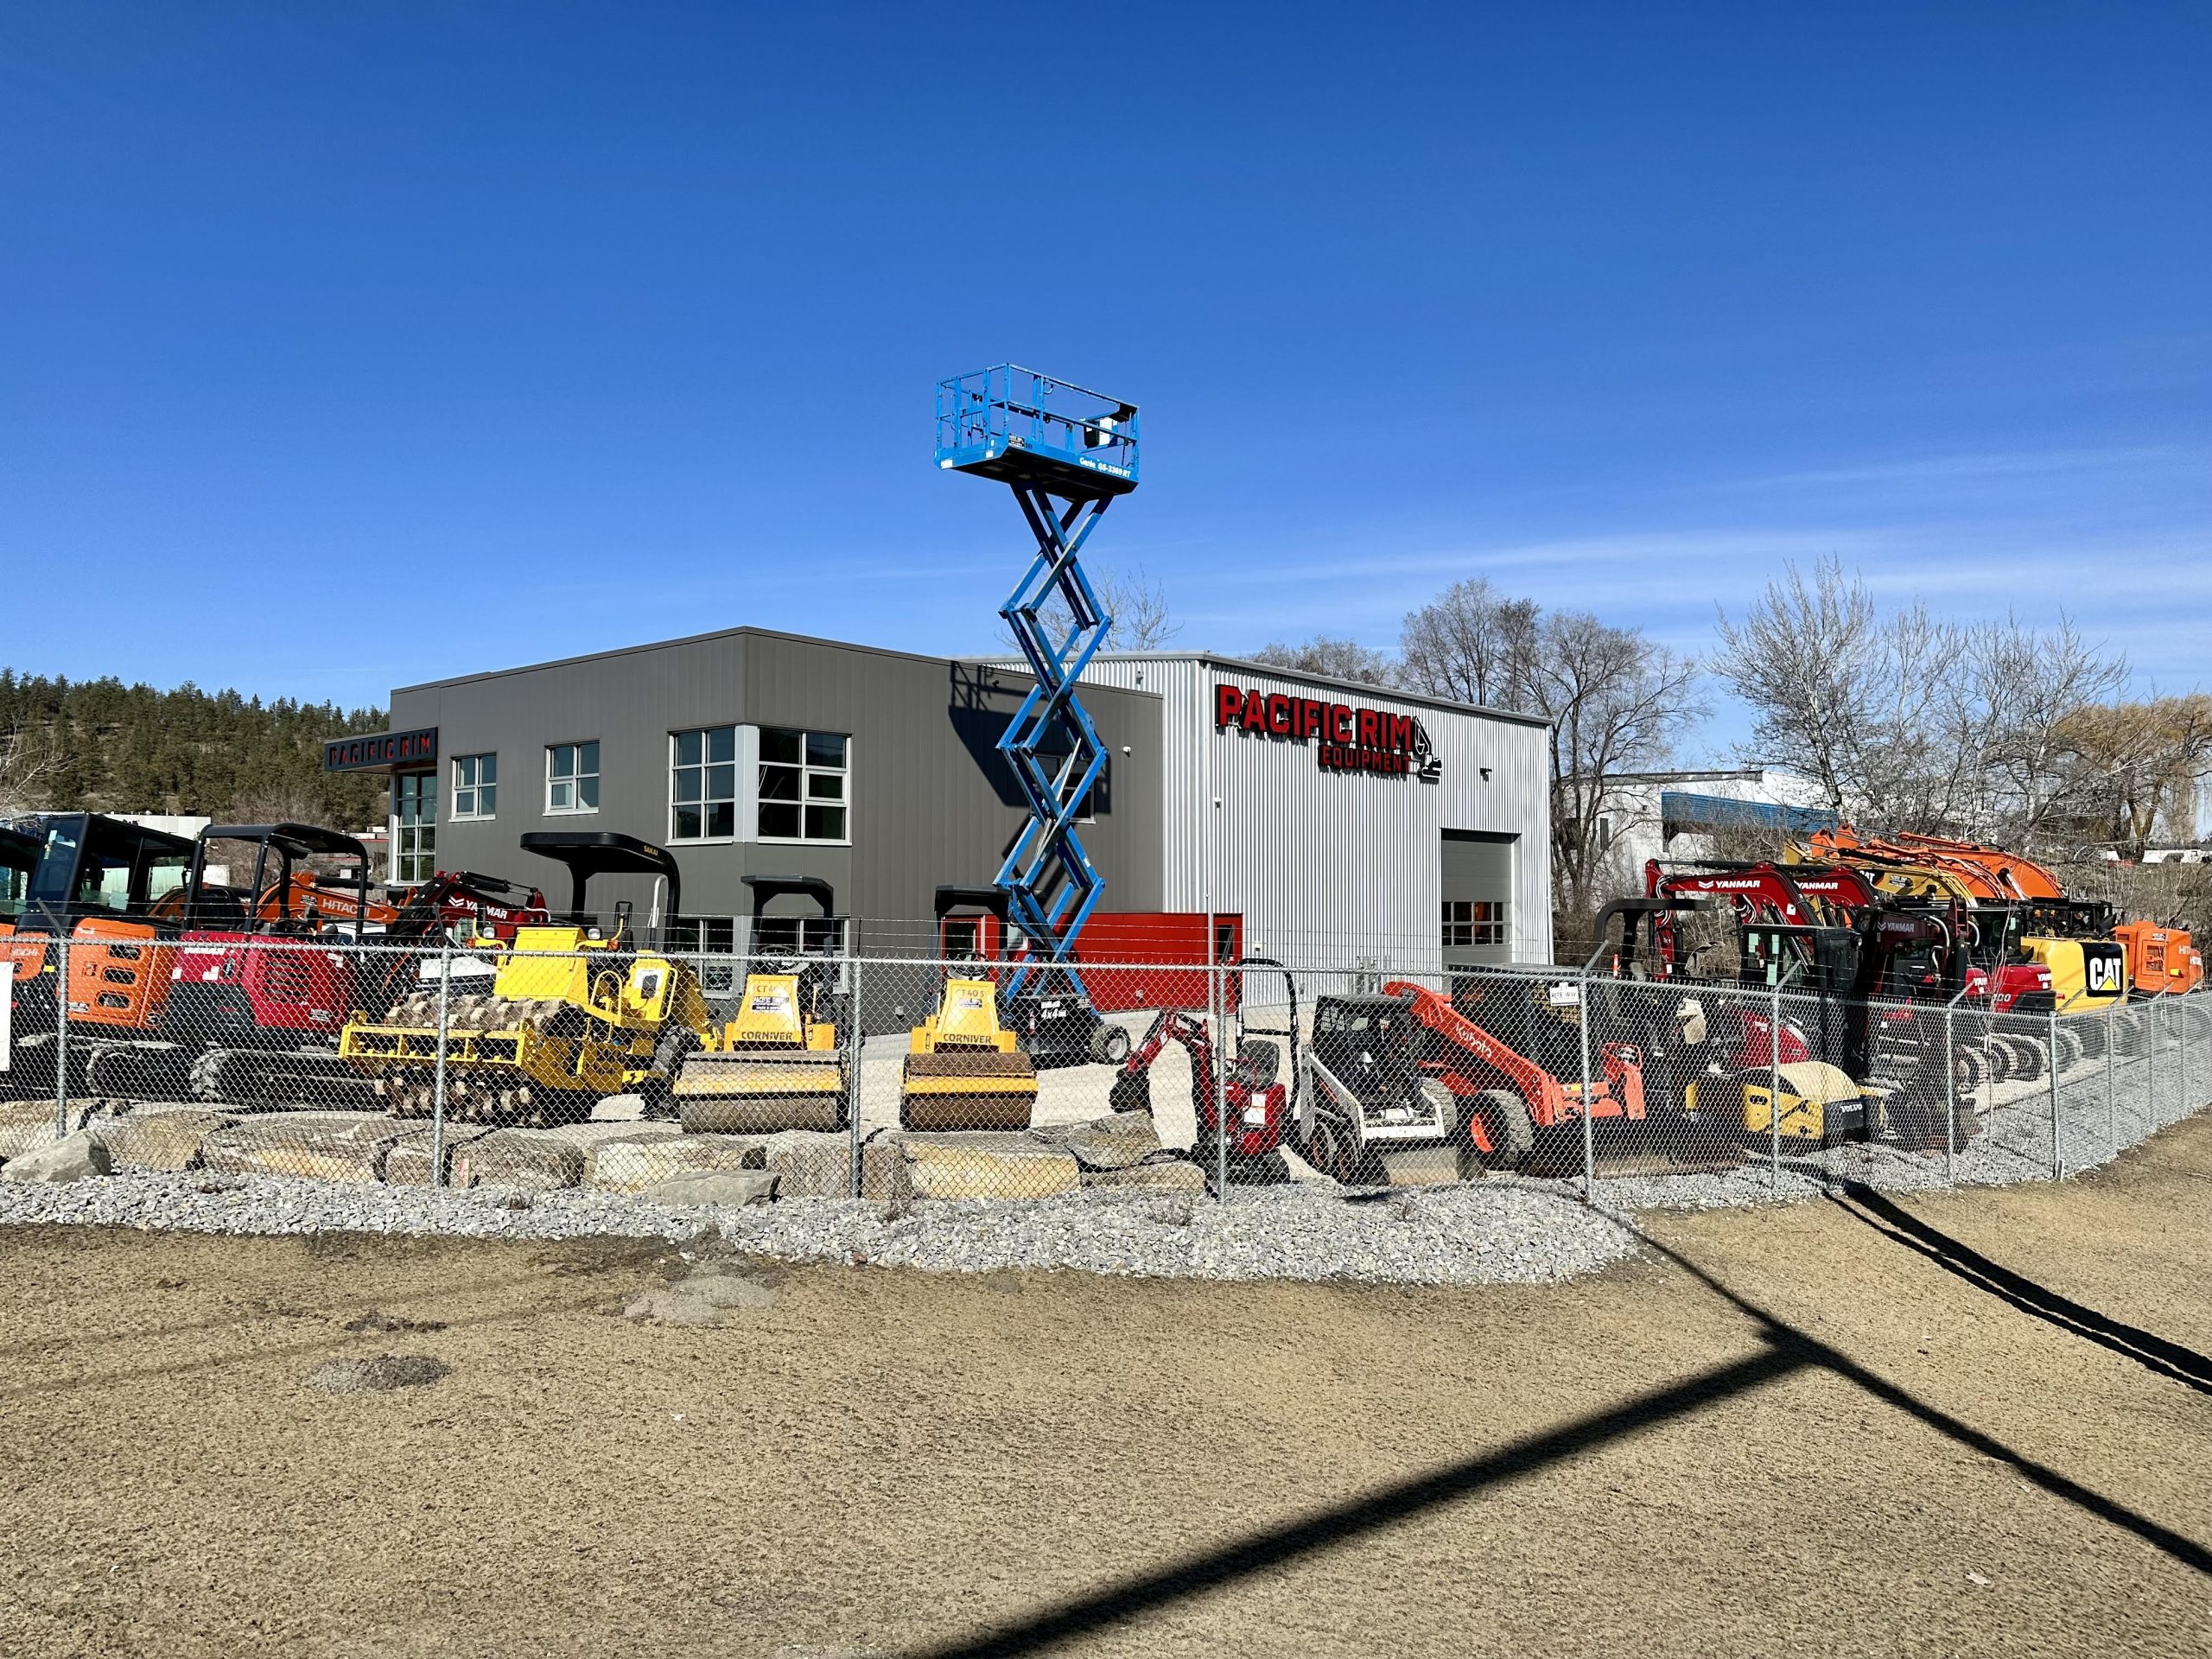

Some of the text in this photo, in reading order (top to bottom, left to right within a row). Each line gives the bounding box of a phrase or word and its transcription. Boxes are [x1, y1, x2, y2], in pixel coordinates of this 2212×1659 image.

[1215, 683, 1412, 753] PACIFIC RIM
[328, 732, 430, 766] PACIFIC RIM
[1318, 745, 1412, 774] EQUIPMENT
[1715, 880, 1761, 889] YANMAR
[1796, 881, 1839, 891] YANMAR
[322, 898, 372, 918] HITACI
[466, 899, 508, 920] YAMAR
[1886, 921, 1916, 933] YANMAR
[2089, 957, 2122, 991] CAT
[967, 989, 979, 998] 40
[741, 1031, 793, 1041] CORNIVER
[943, 1033, 993, 1045] CORNIVER
[1840, 1103, 1863, 1114] VOLVO
